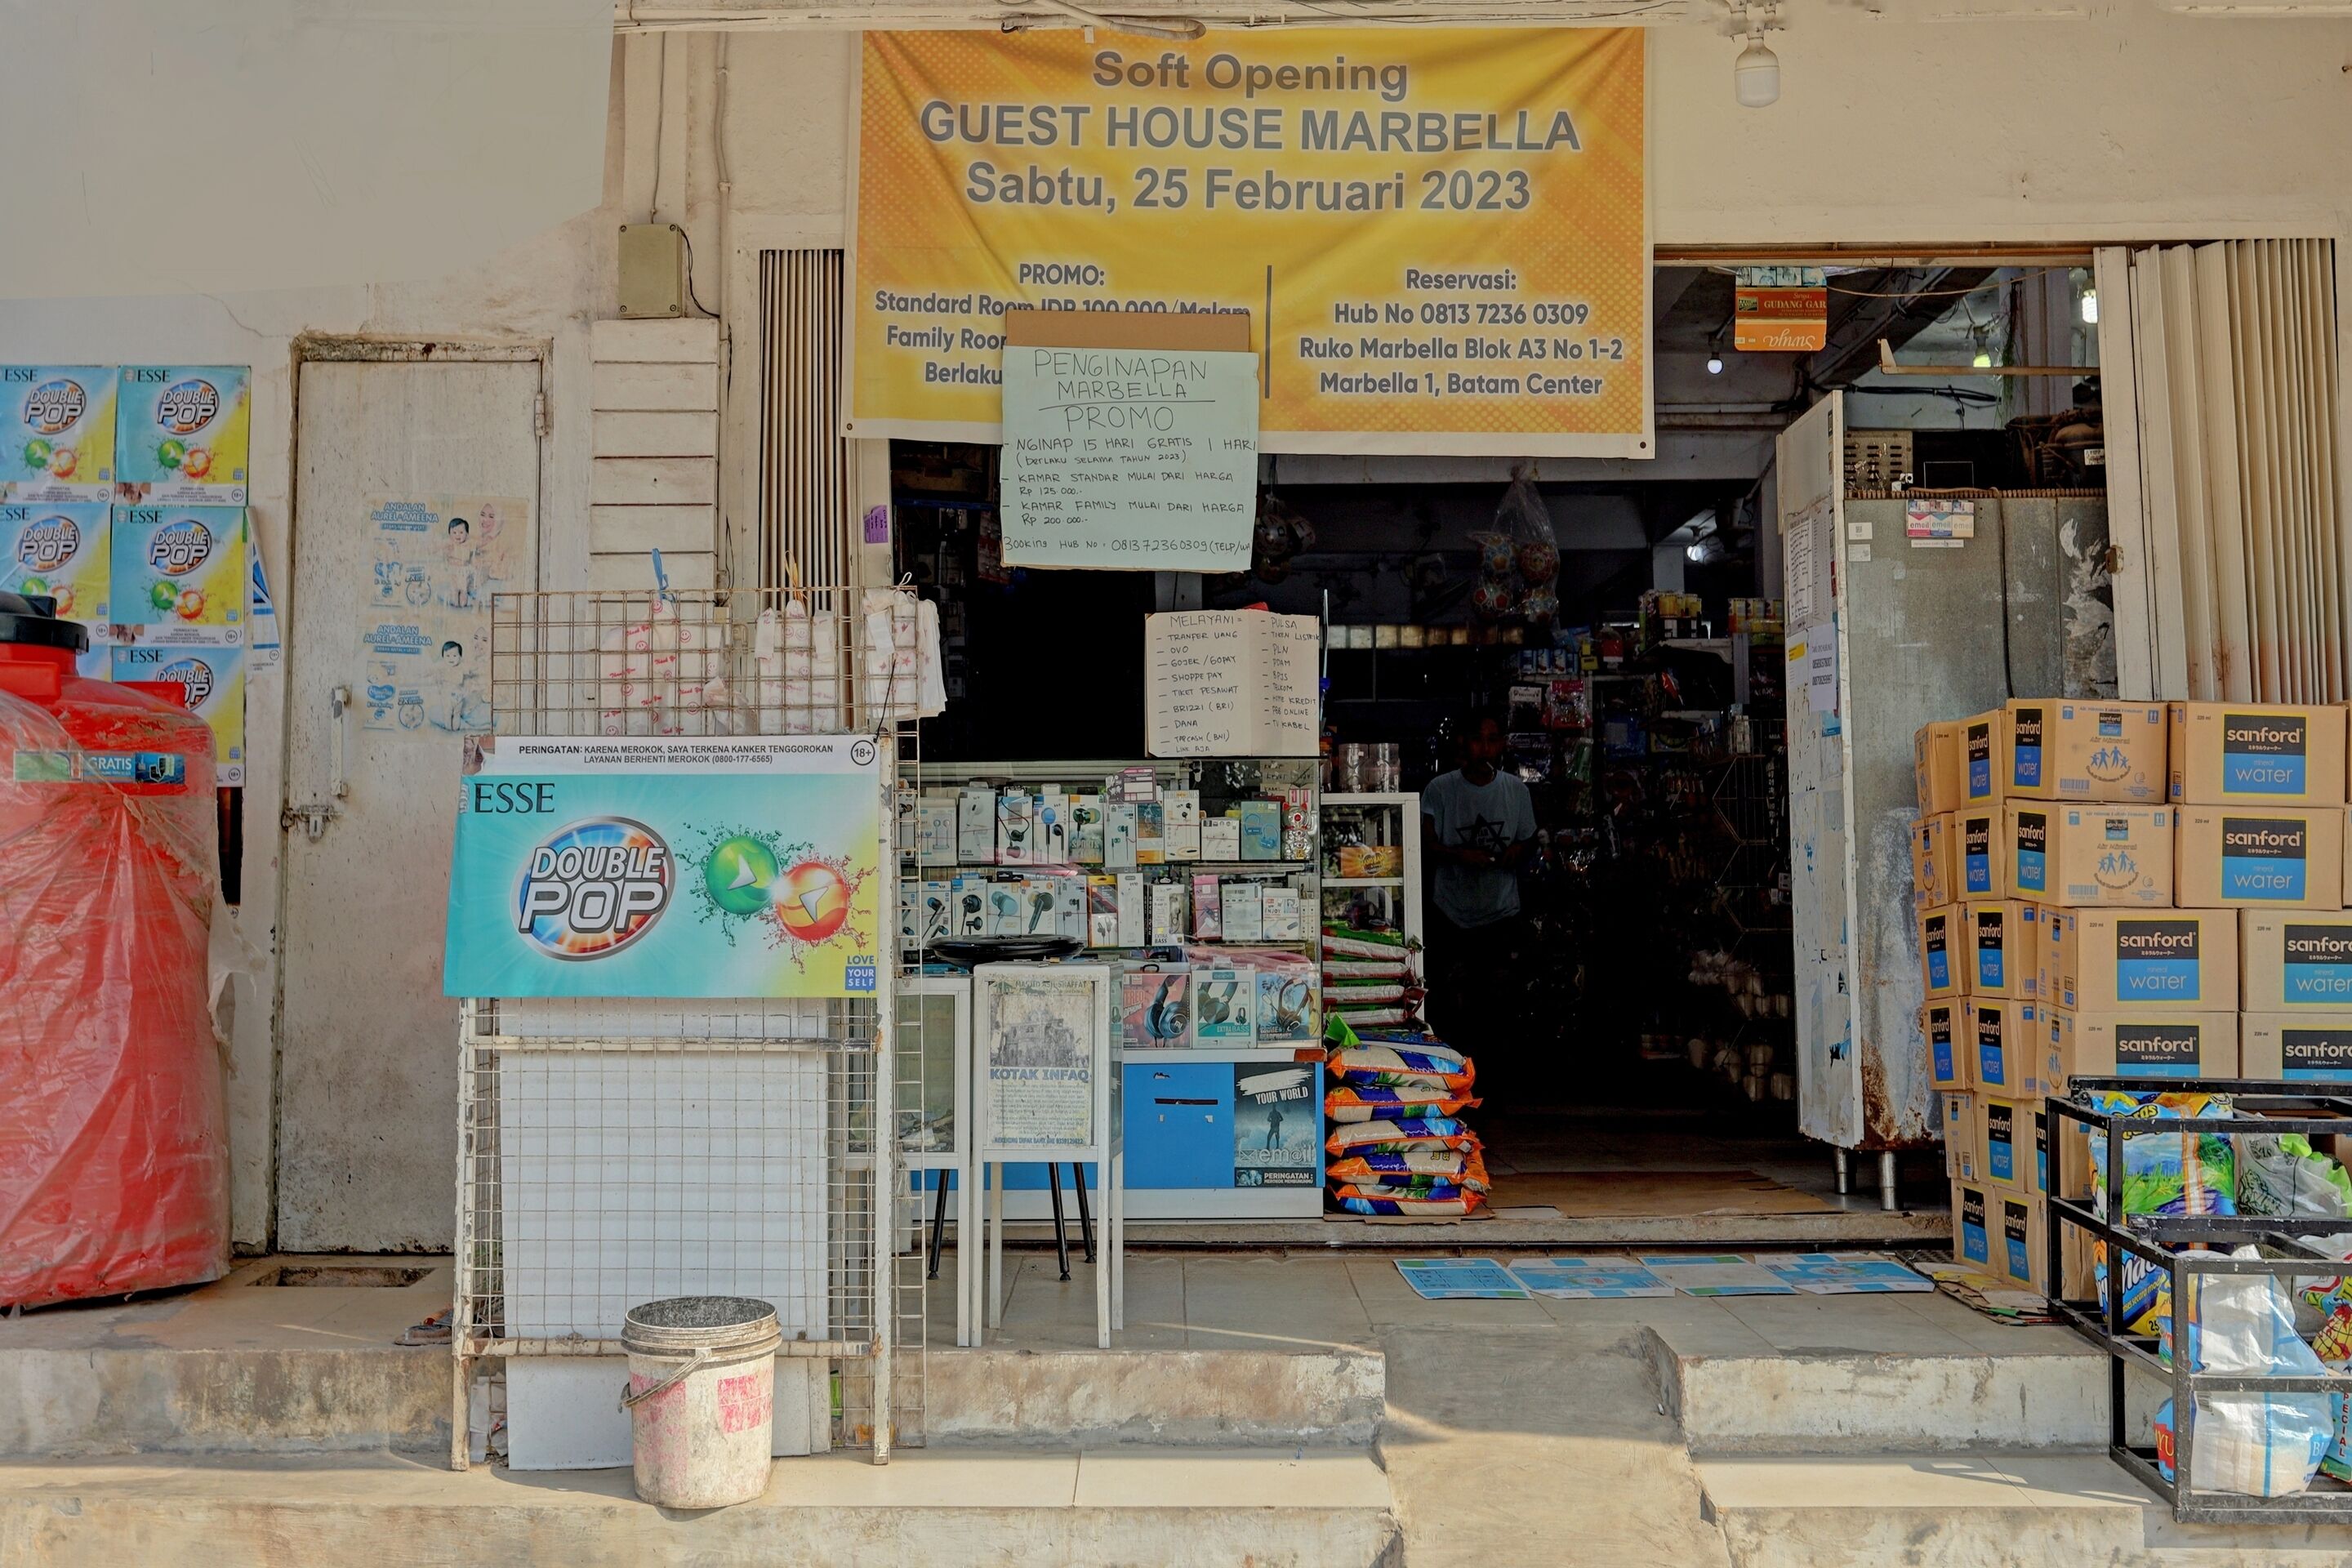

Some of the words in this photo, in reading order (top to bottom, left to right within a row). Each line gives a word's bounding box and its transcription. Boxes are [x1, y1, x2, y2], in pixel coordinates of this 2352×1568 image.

[1093, 51, 1188, 90] Soft
[1205, 54, 1409, 104] Opening
[920, 101, 1091, 146] GUEST
[1106, 107, 1283, 150] HOUSE
[1301, 109, 1582, 152] MARBELLA
[965, 163, 1117, 213] Sabtu,
[1134, 167, 1188, 208] 25
[1205, 167, 1405, 211] Februari
[1421, 171, 1531, 211] 2023
[1019, 264, 1105, 285] PROMO:
[1406, 270, 1516, 289] Reservasi:
[875, 291, 972, 314] Standard
[1335, 304, 1379, 323] Hub
[1386, 304, 1414, 323] No
[1421, 304, 1470, 323] 0813
[1477, 304, 1526, 324] 7236
[1533, 305, 1588, 324] 0309
[888, 325, 955, 352] Family
[1300, 337, 1353, 359] Ruko
[1361, 338, 1458, 359] Marbella
[1465, 339, 1512, 359] Blok
[1517, 339, 1546, 359] A3
[1553, 339, 1582, 359] No
[1589, 340, 1623, 359] 1-2
[925, 362, 1002, 385] Berlaku
[1035, 349, 1206, 382] PENGINAPAN
[5, 368, 38, 381] ESSE
[137, 369, 170, 382] ESSE
[1058, 381, 1187, 400] MARBELLA
[1321, 372, 1418, 393] Marbella
[1425, 373, 1440, 397] 1,
[1447, 373, 1519, 394] Batam
[1526, 373, 1602, 394] Center
[30, 390, 82, 404] DOUBLE
[163, 390, 216, 405] DOUBLE
[24, 404, 82, 424] POP
[157, 404, 216, 424] POP
[1065, 406, 1174, 432] PROMO
[1017, 439, 1073, 452] NGINAP
[1084, 439, 1097, 450] 15
[1106, 438, 1134, 449] HARI
[1147, 438, 1192, 448] GRATIS
[1224, 439, 1256, 450] HARI
[1120, 454, 1151, 463] TAHUN
[1158, 451, 1187, 463] 2023)
[1018, 474, 1060, 483] KAMAR
[1071, 473, 1119, 482] STANDAR
[1128, 472, 1156, 481] MULAI
[1162, 472, 1184, 481] DARI
[1196, 472, 1233, 482] HARGA
[1019, 487, 1032, 496] Rp
[384, 502, 425, 512] ANDALAN
[1021, 501, 1063, 510] KAMAR
[1076, 501, 1116, 510] FAMILY
[1129, 501, 1160, 509] MULAI
[1168, 503, 1192, 511] DARI
[1202, 503, 1244, 513] HARGA
[130, 512, 163, 523] ESSE
[1022, 514, 1036, 526] Rp
[155, 531, 208, 546] DOUBLE
[150, 545, 210, 565] POP
[1271, 617, 1297, 628] PULSA
[1168, 633, 1209, 641] TRANFER
[1201, 686, 1239, 694] PESAWAT
[1174, 720, 1198, 728] DANA
[2016, 719, 2040, 735] sanford
[2226, 727, 2301, 743] sanford
[519, 746, 583, 755] PERINGATAN:
[584, 746, 620, 754] KARENA
[621, 745, 666, 755] MEROKOK,
[667, 745, 689, 754] SAYA
[690, 745, 730, 754] TERKENA
[731, 745, 766, 754] KANKER
[768, 745, 833, 754] TENGGOROKAN
[854, 748, 871, 759] 18+
[584, 755, 623, 764] LAYANAN
[624, 755, 666, 764] BERHENTI
[668, 755, 710, 764] MEROKOK
[712, 755, 773, 764] (0800-177-6565)
[2017, 762, 2038, 776] water
[2235, 768, 2293, 783] water
[474, 783, 555, 813] ESSE
[2019, 824, 2045, 841] sanford
[2225, 830, 2301, 846] sanford
[532, 846, 666, 880] DOUBLE
[2234, 875, 2292, 889] water
[518, 880, 668, 933] POP
[1979, 923, 2002, 938] sanford
[2120, 932, 2194, 948] sanford
[847, 956, 875, 964] LOVE
[847, 969, 875, 978] YOUR
[847, 978, 875, 987] SELF
[2129, 974, 2187, 990] water
[2119, 1036, 2194, 1053] sanford
[990, 1068, 1039, 1080] KOTAK
[1043, 1069, 1089, 1083] INFAQ
[1255, 1091, 1278, 1104] YOUR
[1280, 1086, 1308, 1101] WORLD
[1989, 1116, 2011, 1132] sanford
